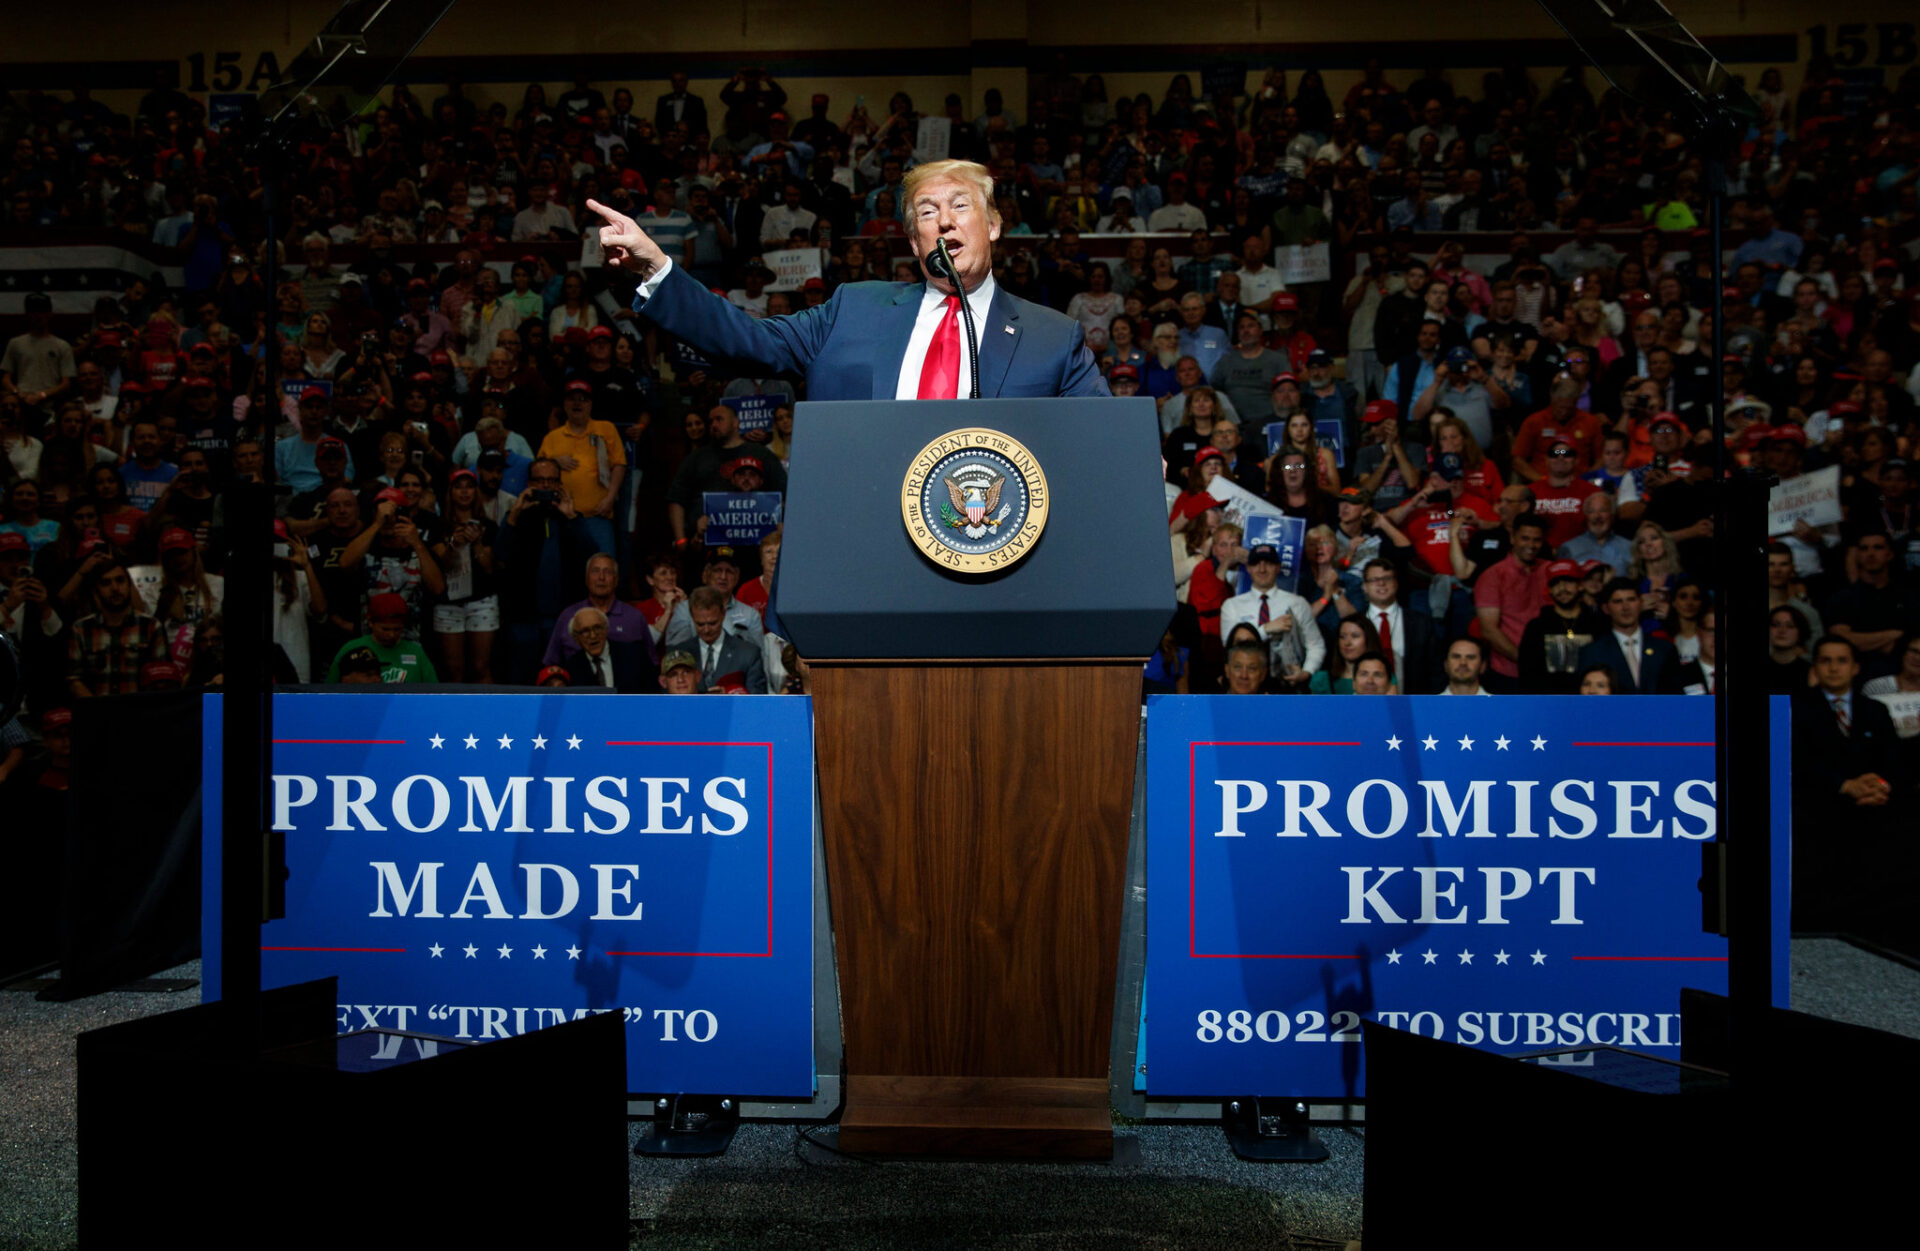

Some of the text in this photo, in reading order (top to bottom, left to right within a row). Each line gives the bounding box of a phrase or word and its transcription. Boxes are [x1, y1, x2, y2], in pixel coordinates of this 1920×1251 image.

[1808, 24, 1915, 66] 15B
[187, 51, 280, 92] 15A
[741, 399, 767, 409] KEEP
[739, 420, 770, 431] GREAT
[708, 511, 780, 526] AMERICA
[728, 499, 757, 510] KEEP
[907, 434, 1044, 567] SEAL OF THE PRESIDENT OF THE UNITED STATES
[725, 528, 761, 540] GREAT
[1281, 544, 1294, 578] KEEP
[271, 774, 749, 836] PROMISES
[1214, 778, 1717, 840] PROMISES
[368, 861, 643, 921] MADE
[1340, 866, 1596, 925] KEPT
[653, 1009, 718, 1043] TO
[1196, 1009, 1681, 1046] 88022 TO SUBSCRI
